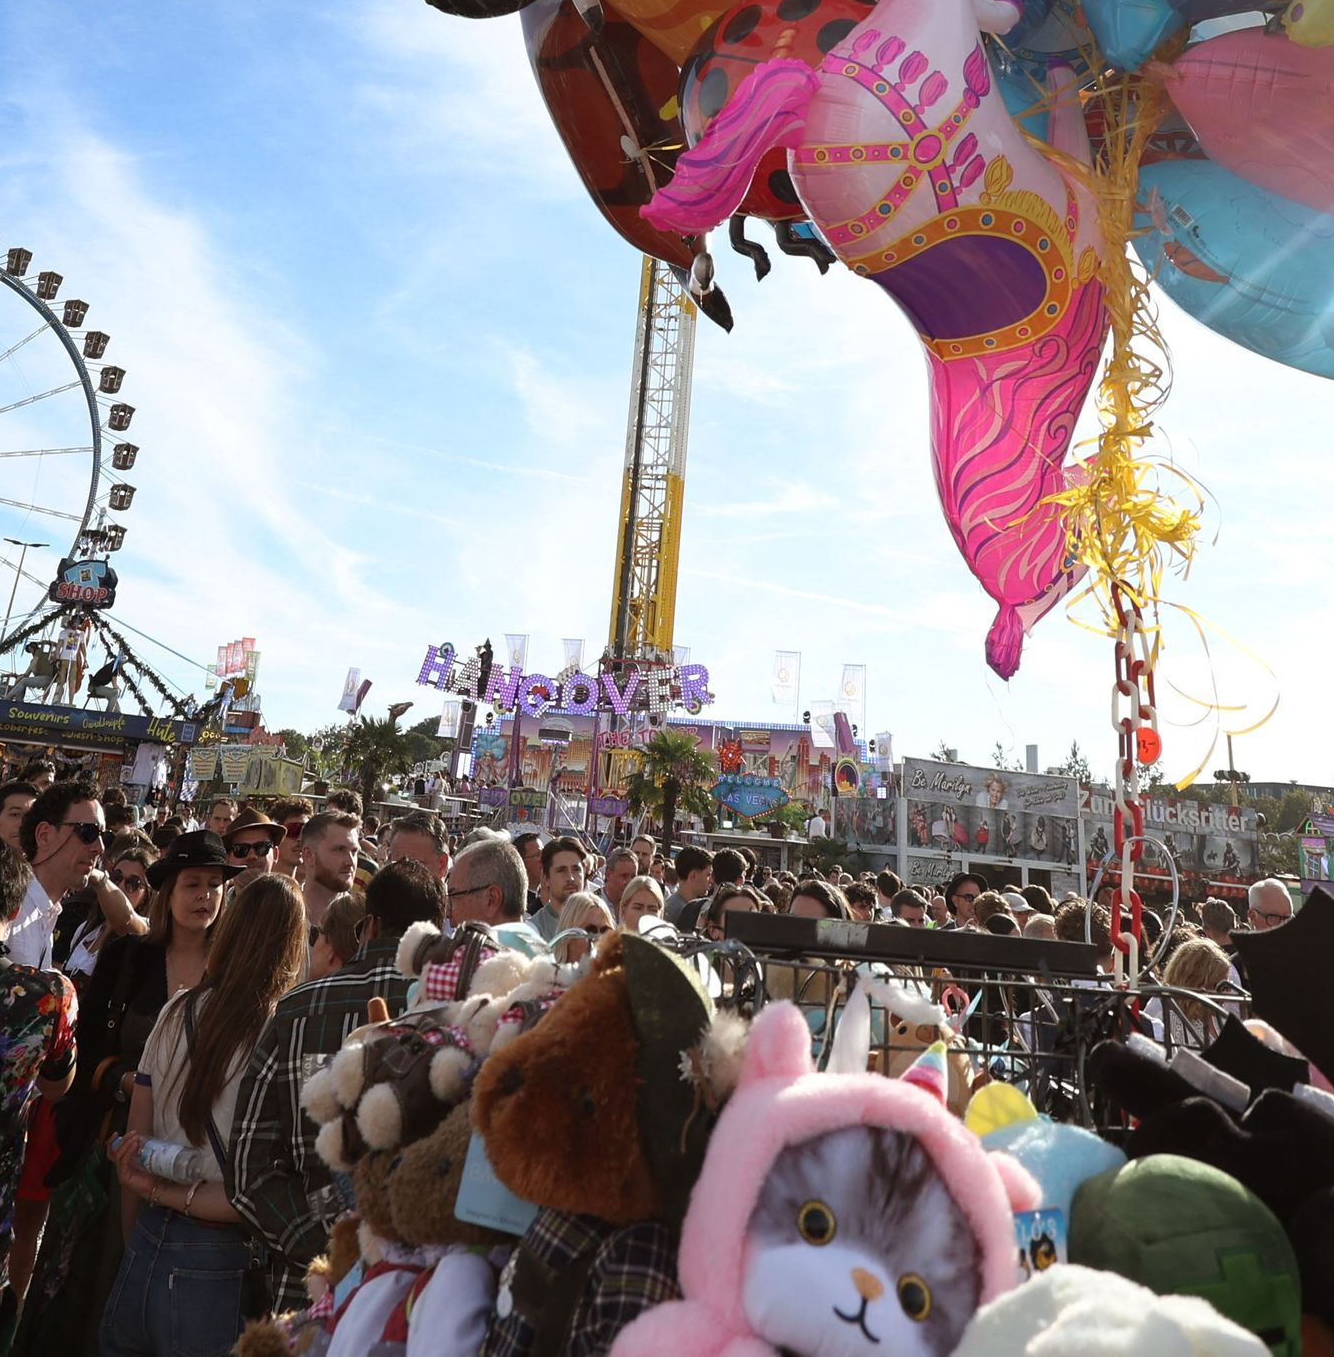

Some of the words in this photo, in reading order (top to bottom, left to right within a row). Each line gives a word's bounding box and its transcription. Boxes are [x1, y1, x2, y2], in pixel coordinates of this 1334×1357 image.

[56, 581, 109, 602] SHOP
[416, 644, 716, 718] HANGOVER
[8, 707, 69, 725] Souvenirs
[912, 769, 926, 789] Be
[930, 770, 973, 801] Marilyn
